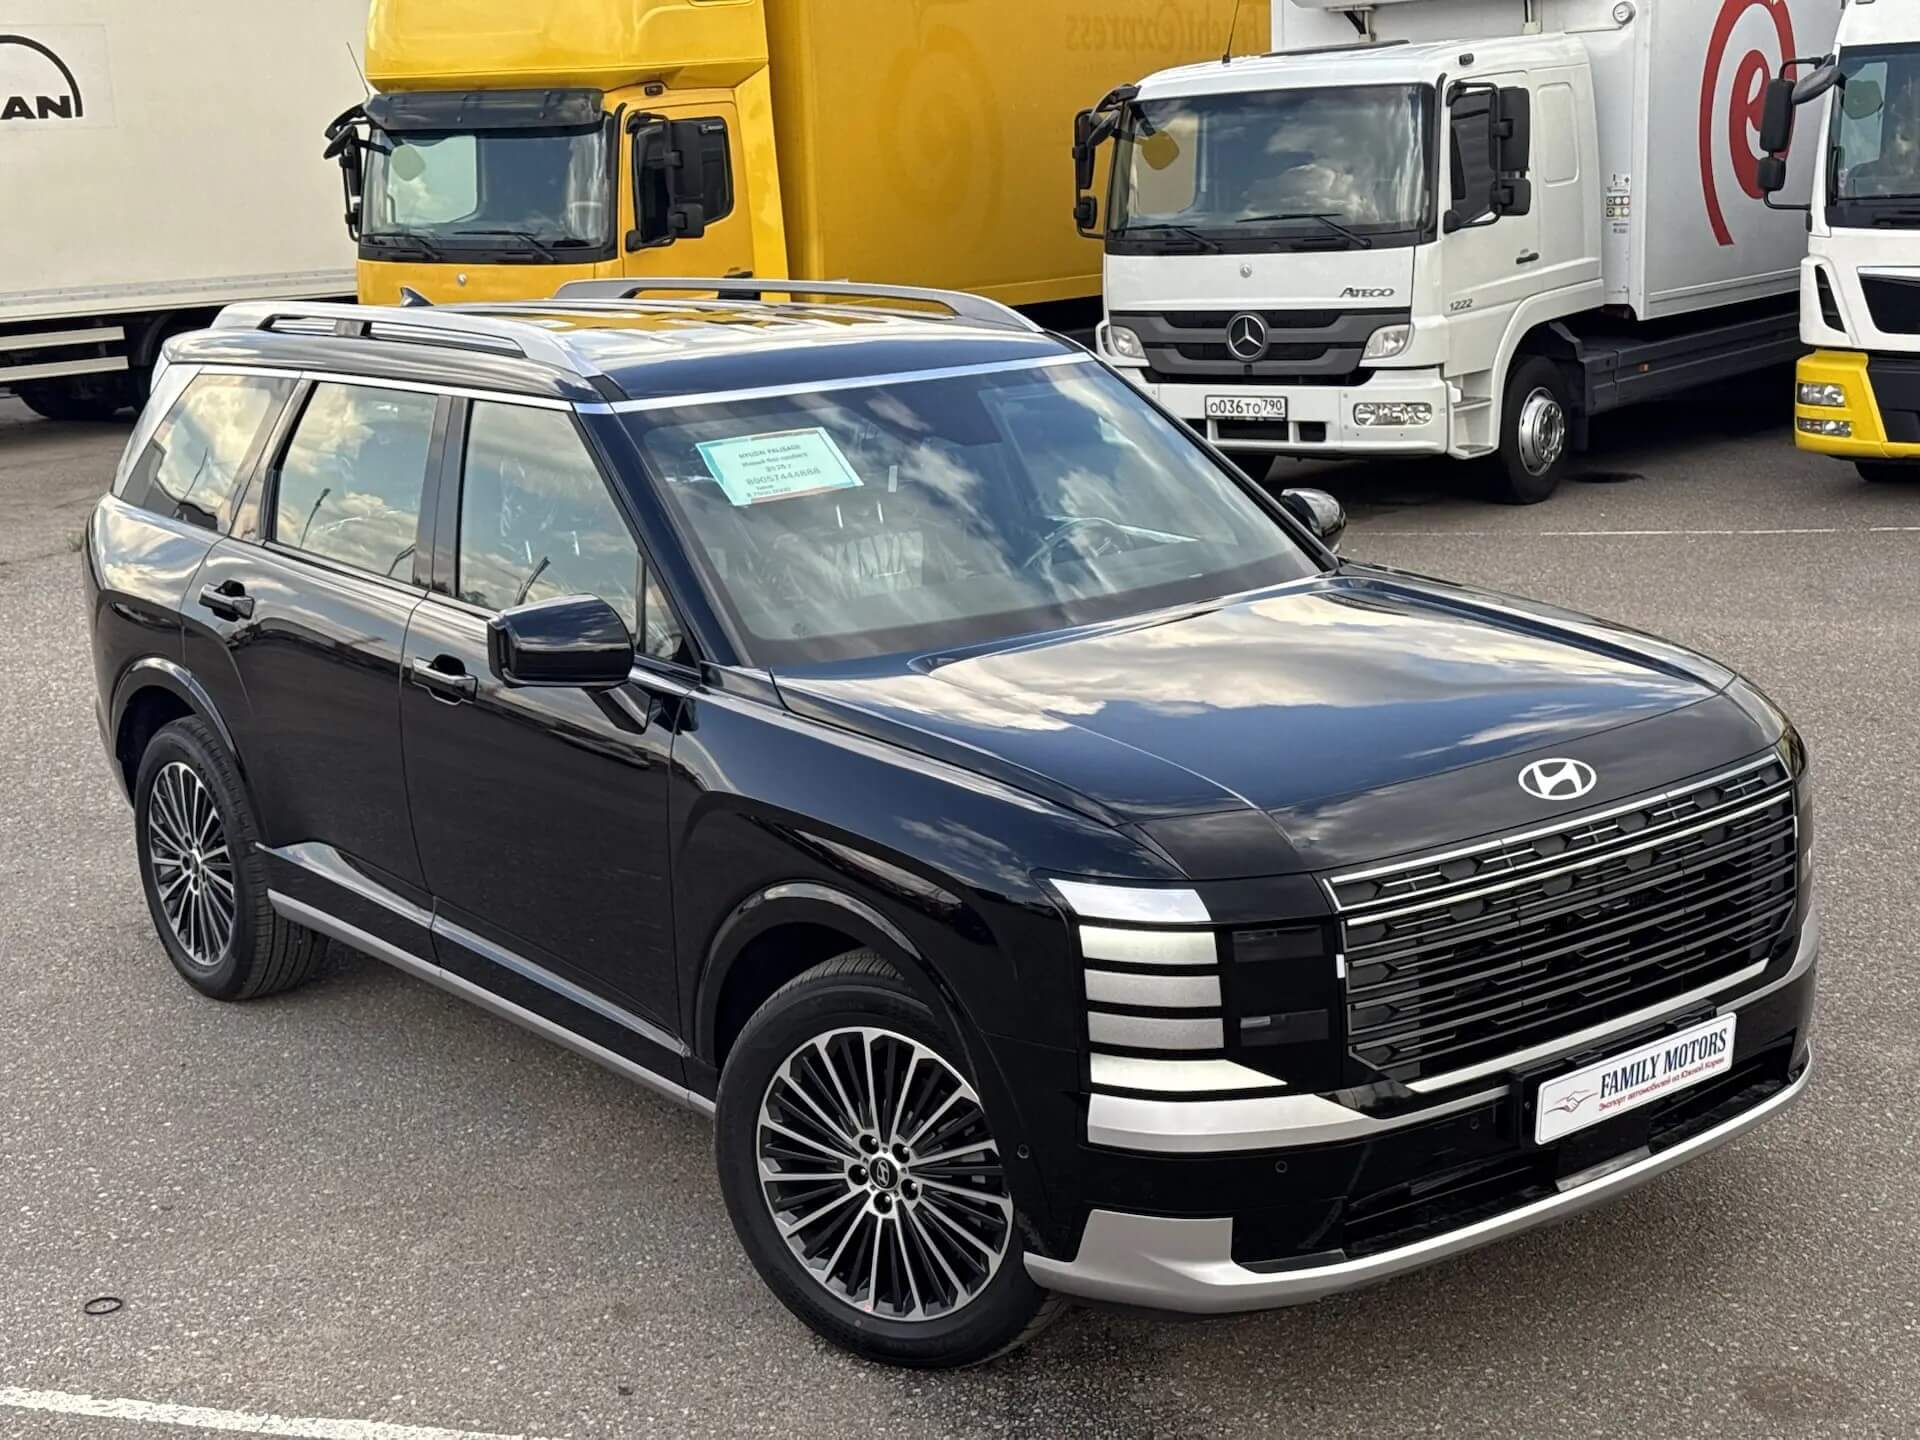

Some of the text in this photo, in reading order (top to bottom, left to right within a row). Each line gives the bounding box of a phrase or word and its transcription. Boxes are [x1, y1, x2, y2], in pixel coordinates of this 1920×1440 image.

[0, 95, 72, 120] AN
[1450, 299, 1472, 311] 1222
[1600, 1028, 1727, 1099] FAMILY MOTORS
